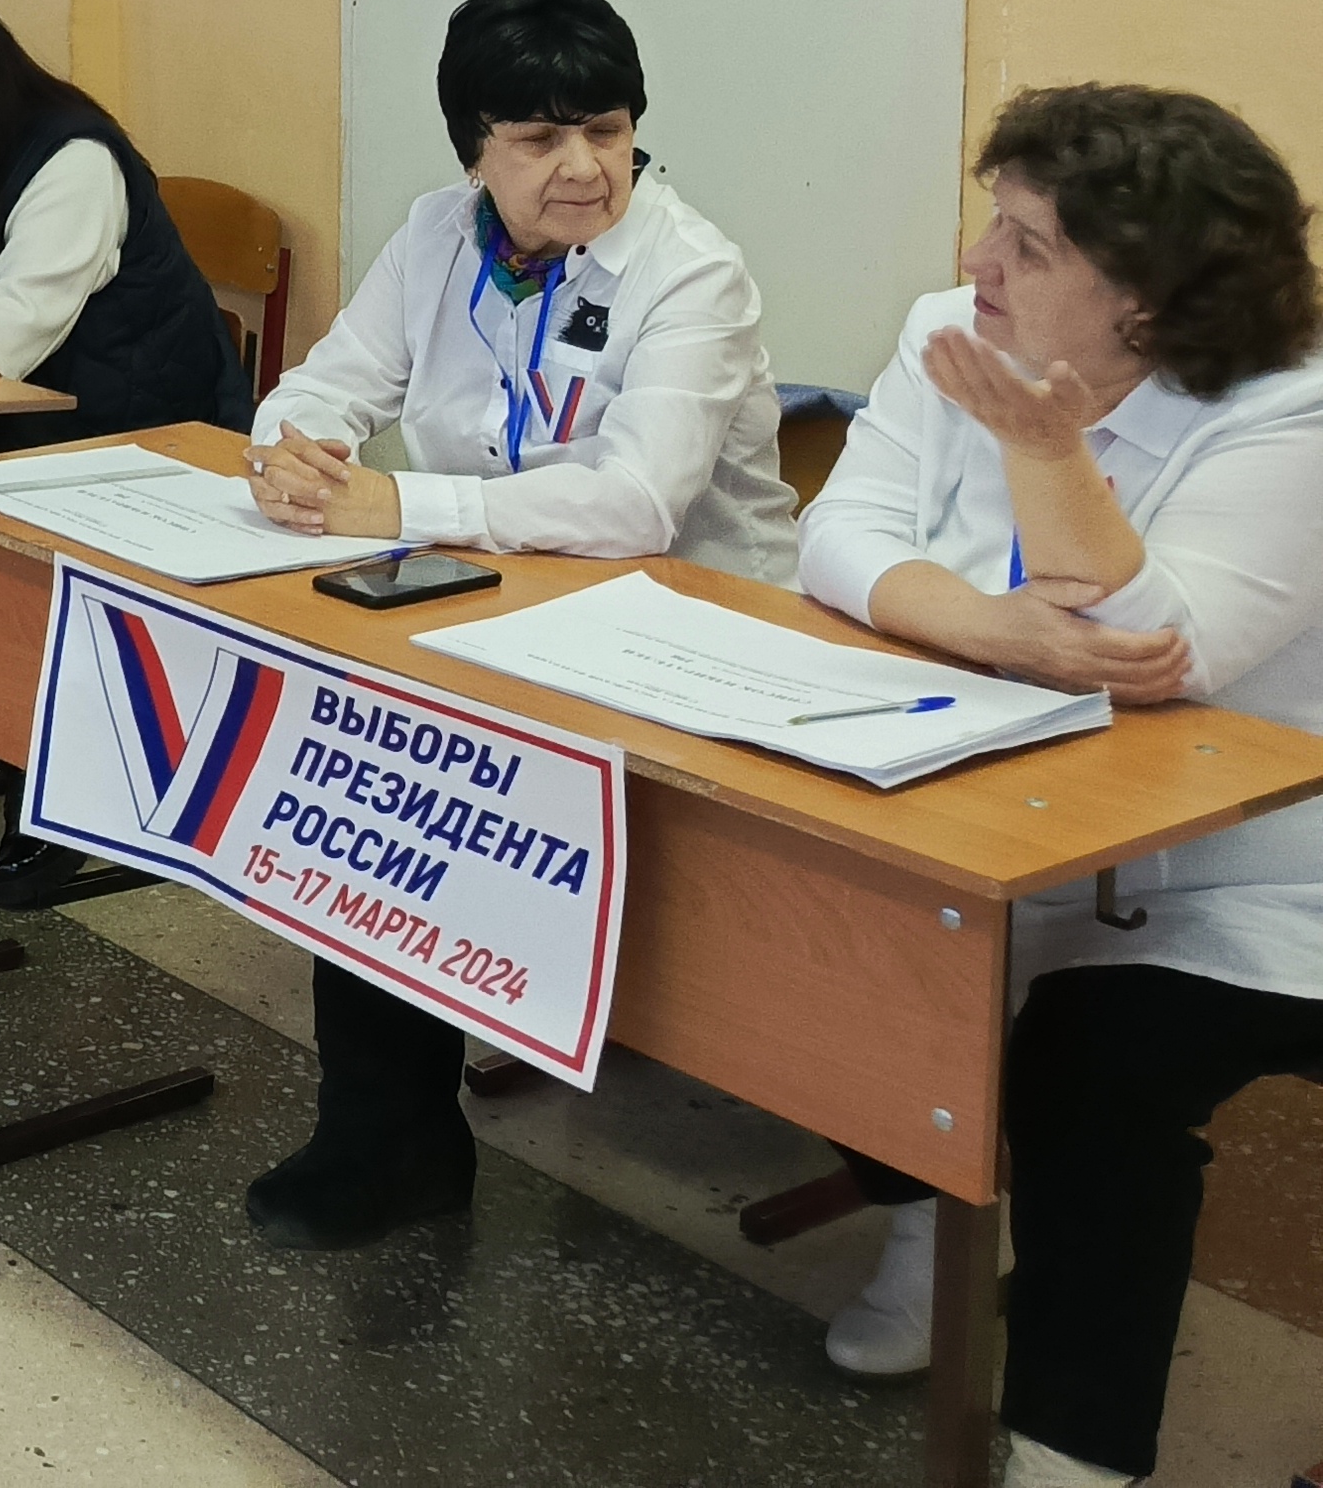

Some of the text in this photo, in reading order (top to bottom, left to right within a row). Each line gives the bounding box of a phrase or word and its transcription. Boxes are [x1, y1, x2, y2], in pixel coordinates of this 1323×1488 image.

[310, 686, 522, 796] ВЫБОРЫ
[262, 790, 449, 902] РОССИИ
[290, 737, 590, 896] ПРЕЗИДЕНТА
[326, 883, 442, 964] МАРТА
[438, 938, 529, 1005] 2024
